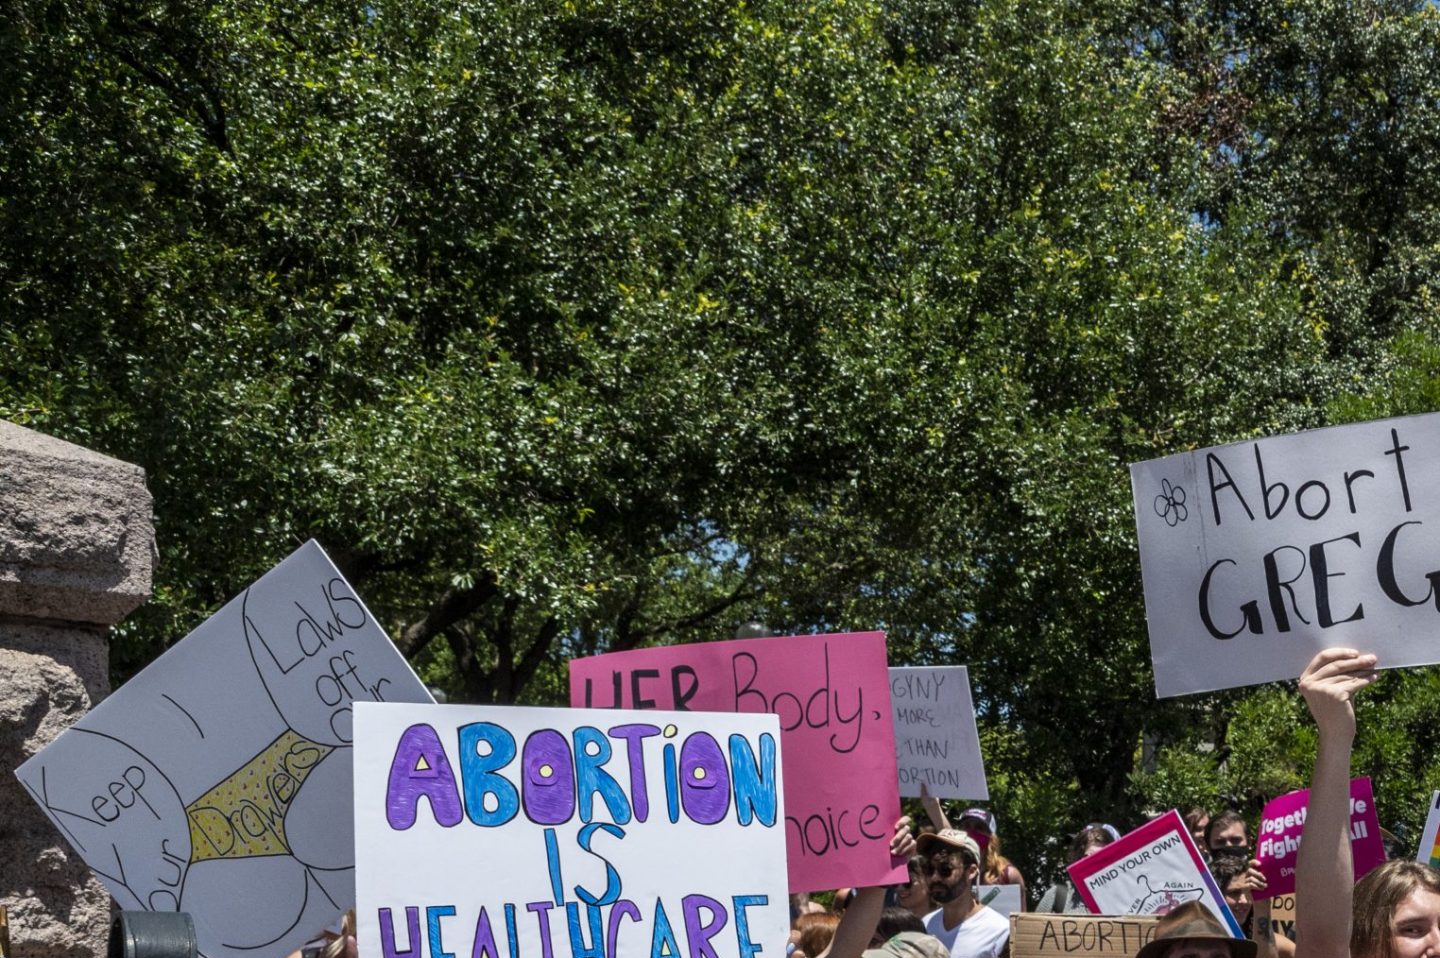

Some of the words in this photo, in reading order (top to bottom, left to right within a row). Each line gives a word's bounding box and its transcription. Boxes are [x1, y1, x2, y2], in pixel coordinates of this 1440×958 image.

[1206, 427, 1412, 526] Abort
[246, 577, 366, 675] Laws
[315, 649, 361, 707] off
[193, 740, 321, 856] Drawers
[544, 822, 626, 906] IS
[1089, 868, 1119, 891] MIND
[1120, 851, 1151, 872] YOUR
[1151, 834, 1181, 857] OWN
[1163, 881, 1194, 889] AGAIN
